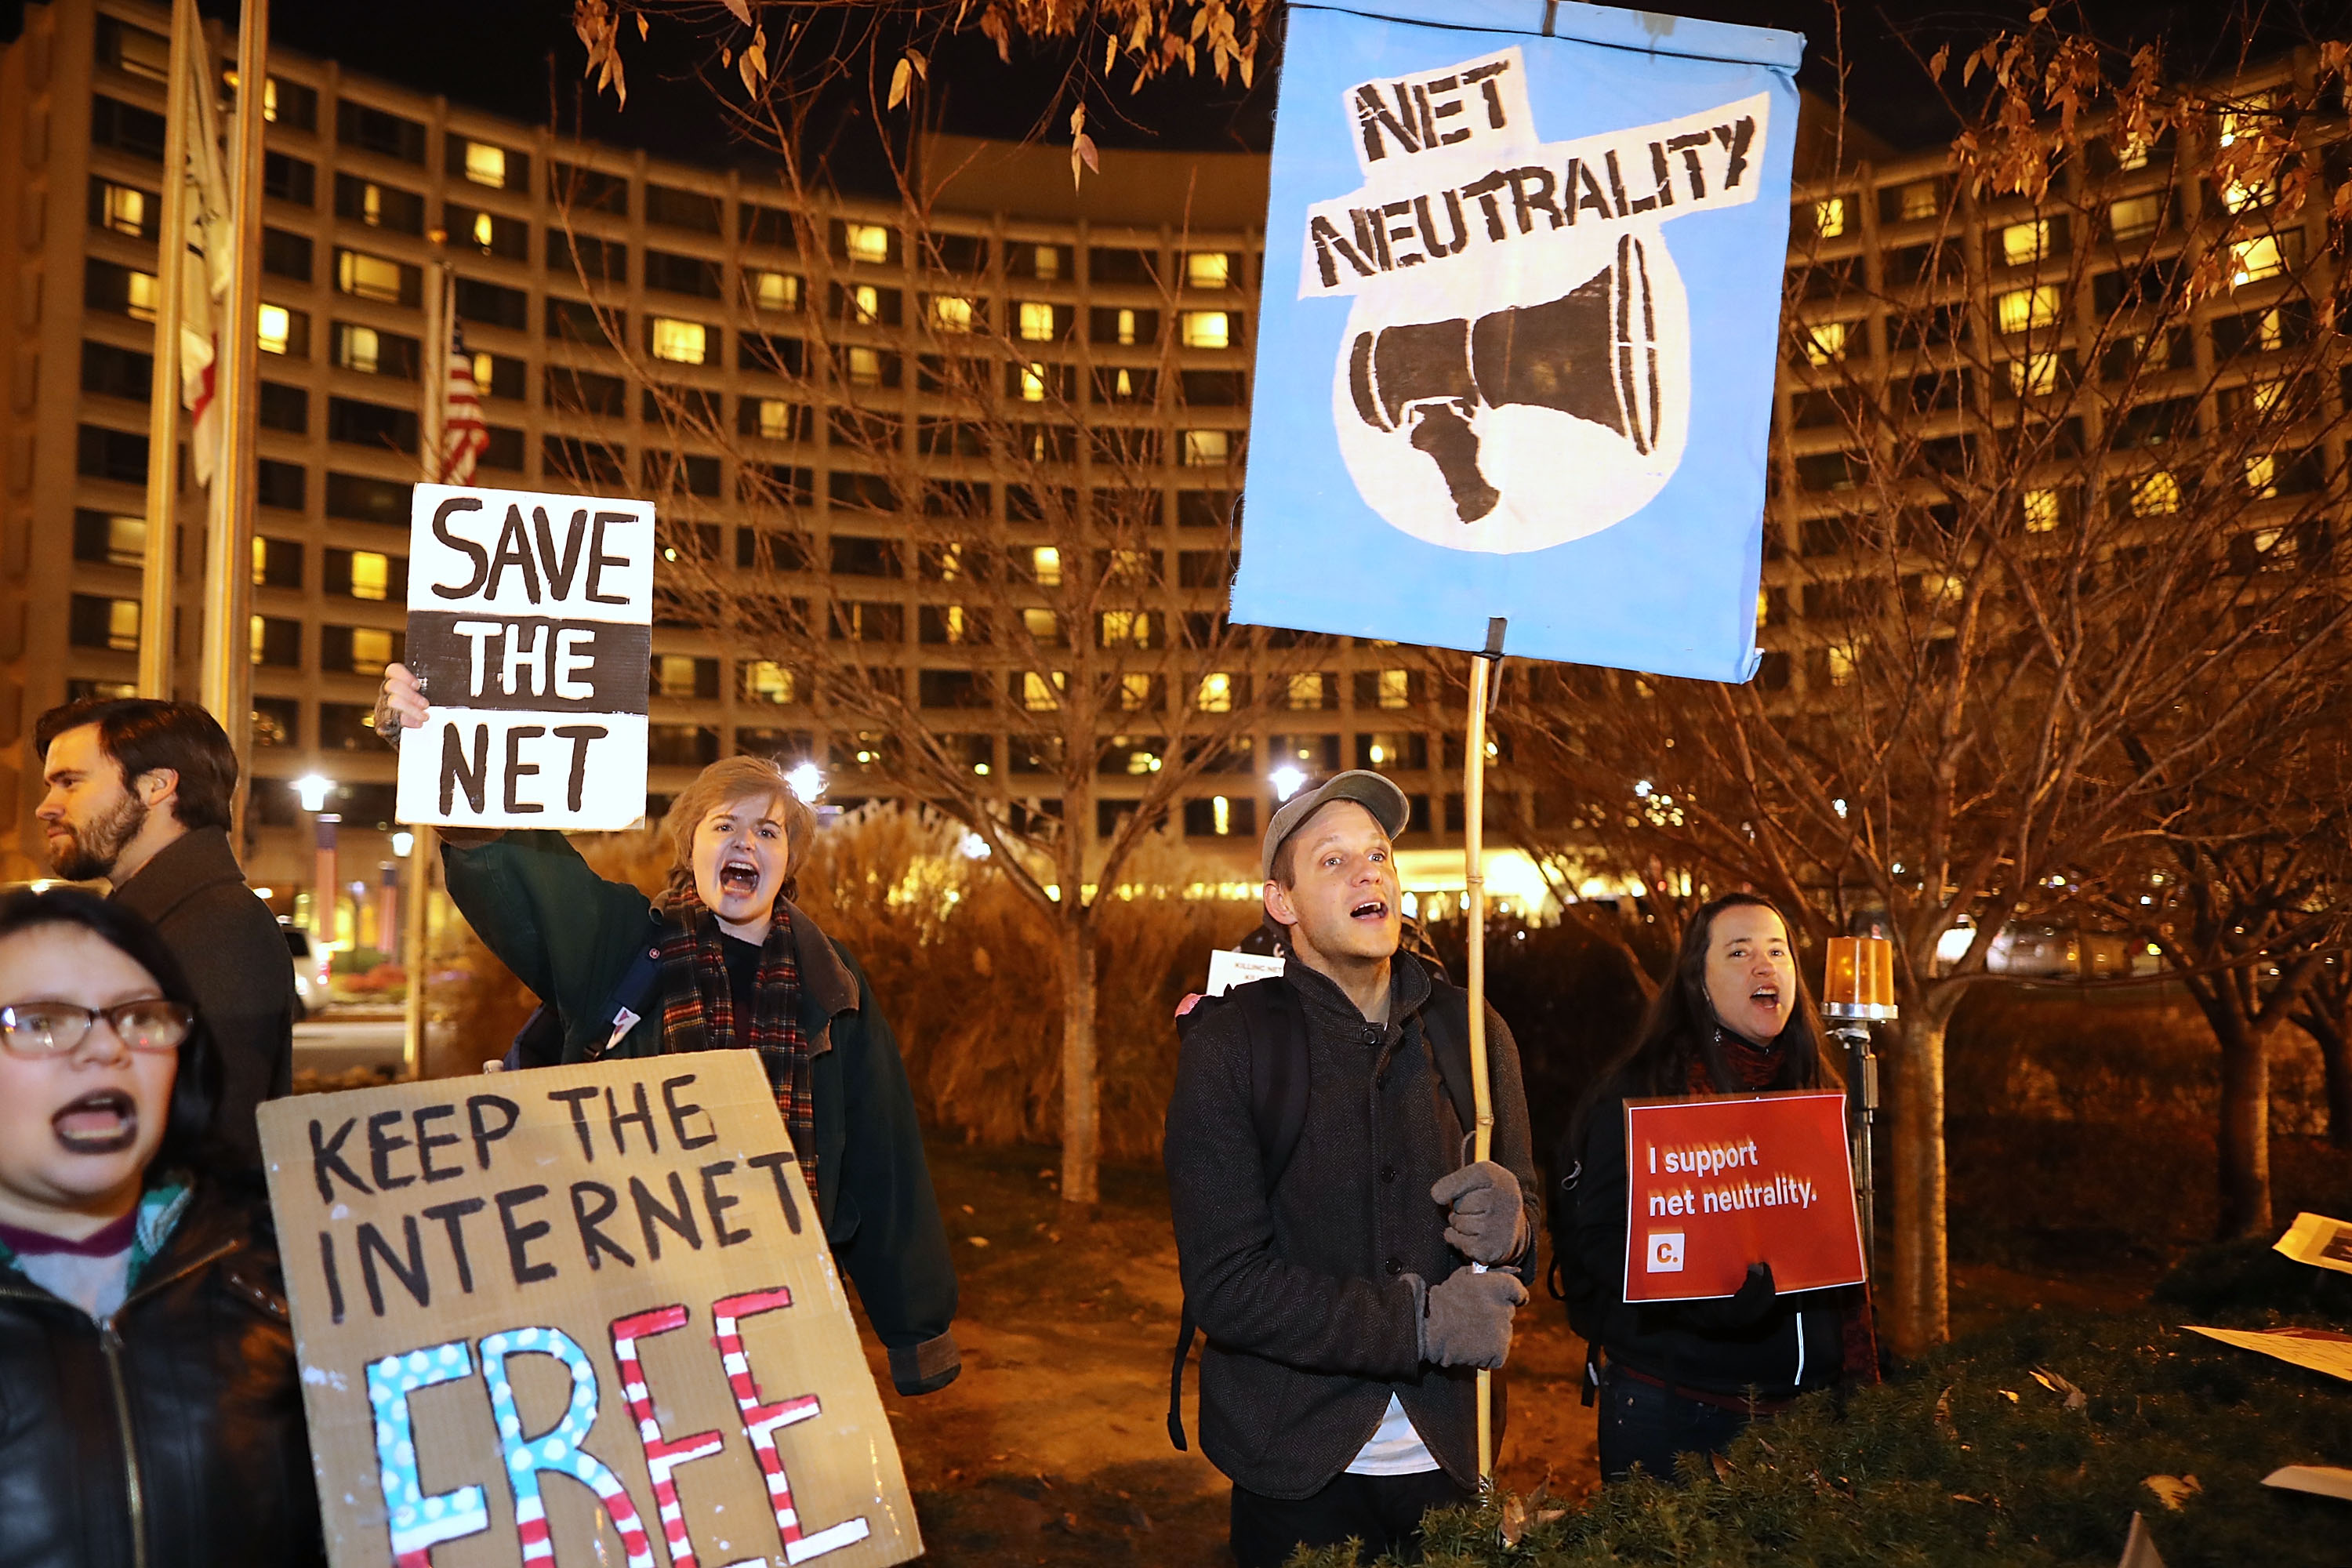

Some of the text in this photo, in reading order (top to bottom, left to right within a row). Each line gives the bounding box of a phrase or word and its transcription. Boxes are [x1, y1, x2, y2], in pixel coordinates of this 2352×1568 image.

[1356, 60, 1510, 162] NET
[1310, 114, 1756, 289] NEUTRALITY
[431, 498, 639, 604] SAVE
[452, 621, 596, 700] THE
[439, 722, 608, 817] NET
[309, 1074, 717, 1203] KEEP THE
[1650, 1141, 1759, 1178] I support
[318, 1151, 804, 1325] INTERNET
[1650, 1177, 1817, 1217] net neutrality.
[365, 1287, 869, 1568] FREE
